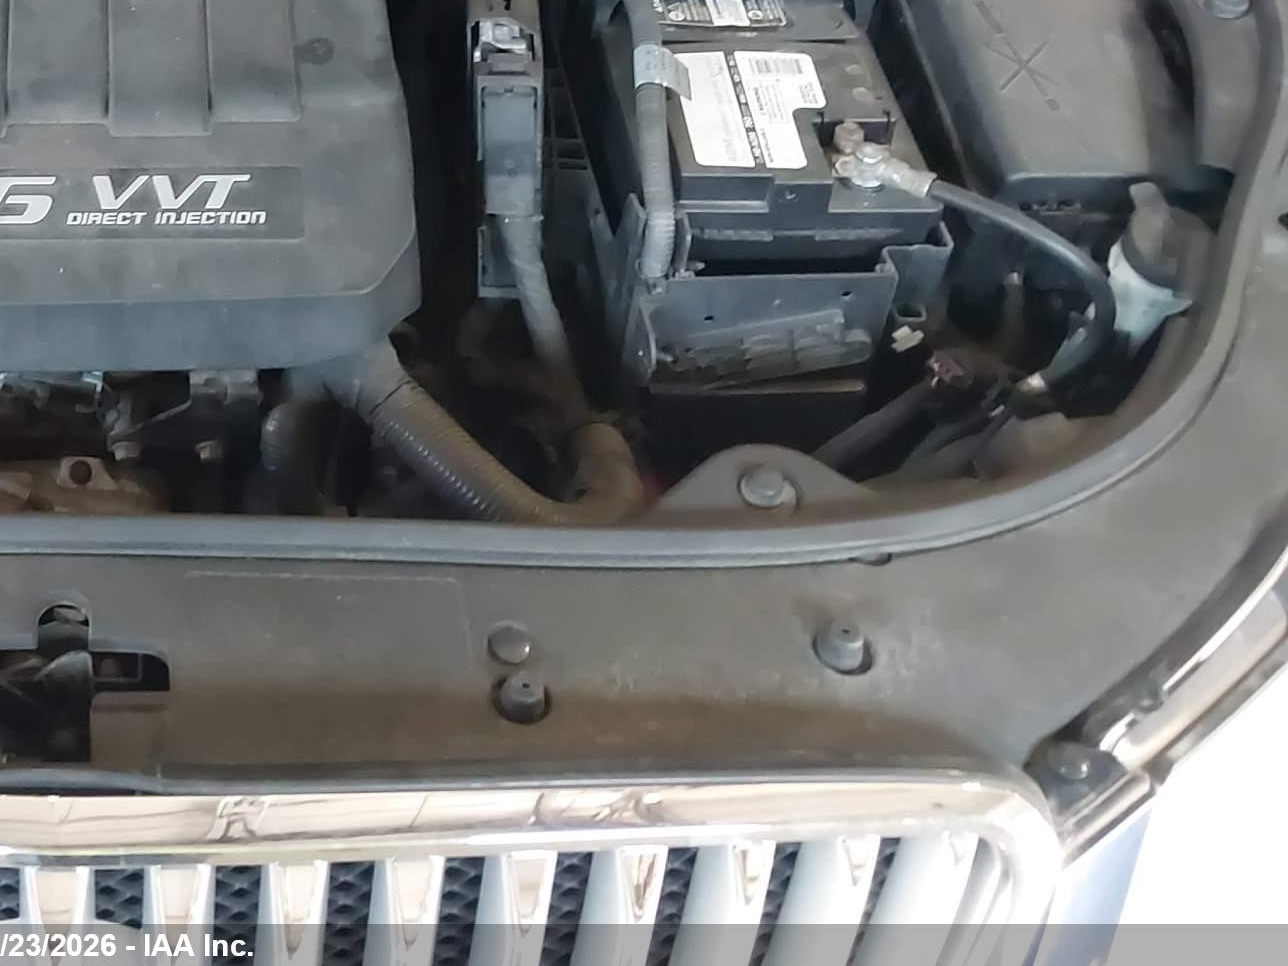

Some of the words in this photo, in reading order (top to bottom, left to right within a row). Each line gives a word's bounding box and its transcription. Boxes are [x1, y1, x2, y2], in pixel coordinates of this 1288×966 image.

[92, 173, 251, 209] VVT
[66, 211, 148, 227] DIRECT
[154, 211, 267, 226] INJECTION
